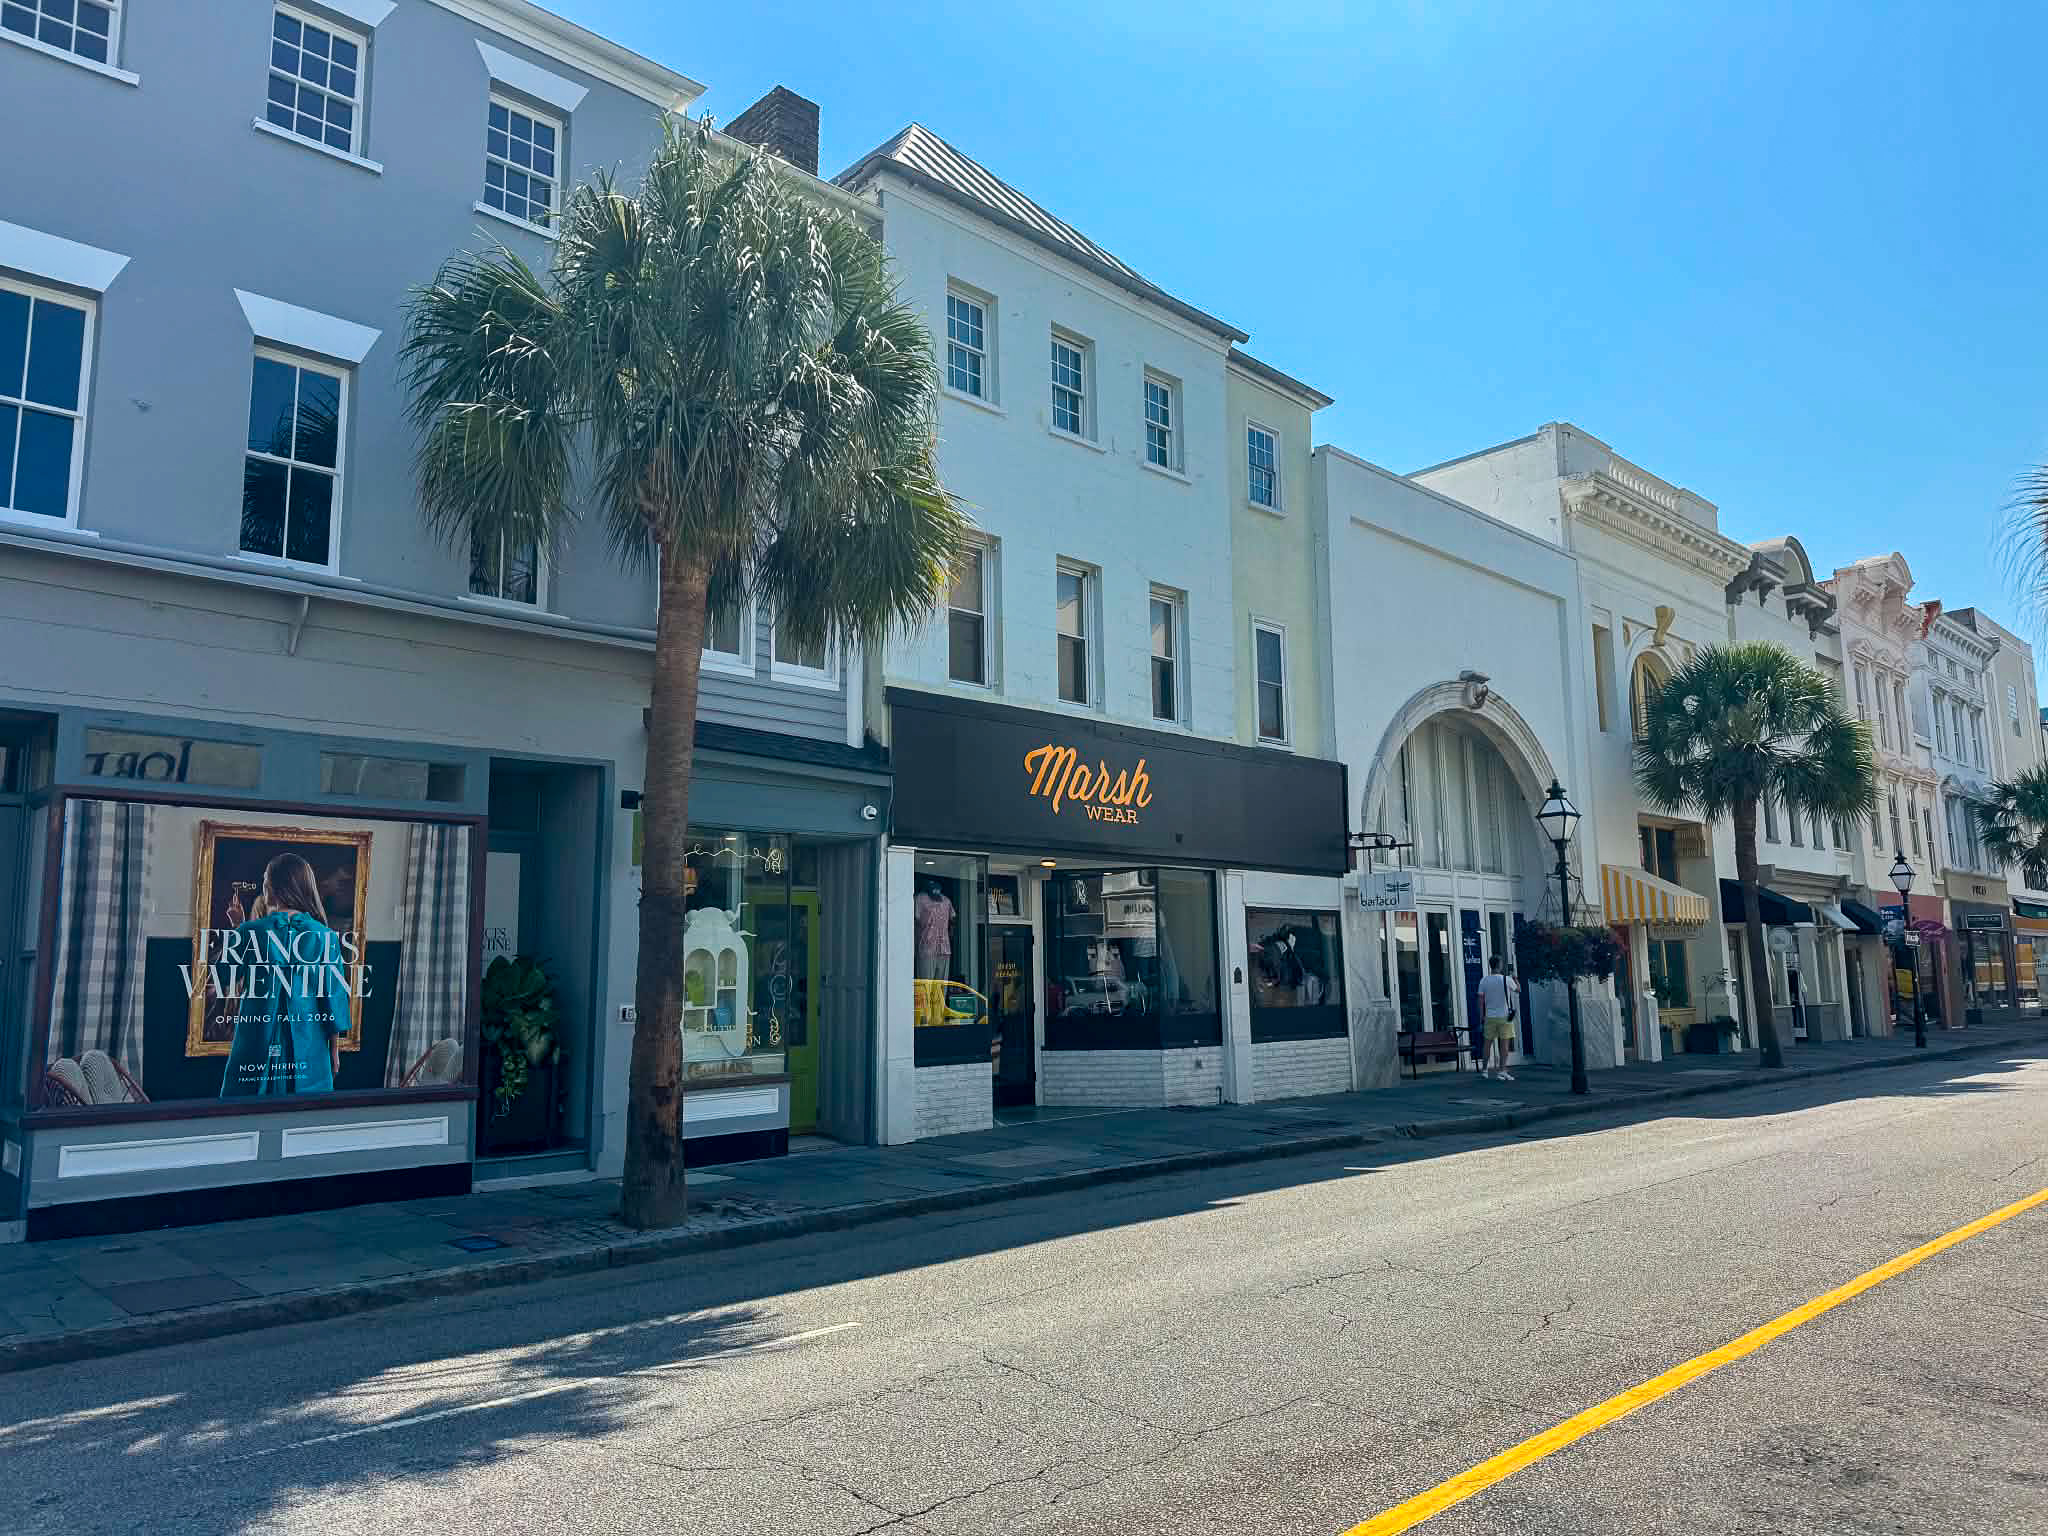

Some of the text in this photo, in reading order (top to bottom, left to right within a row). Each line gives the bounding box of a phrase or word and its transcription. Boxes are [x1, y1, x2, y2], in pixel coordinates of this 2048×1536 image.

[1024, 744, 1152, 815] Marsh
[1084, 804, 1138, 824] WEAR
[199, 928, 360, 965] FRANCES
[177, 964, 373, 999] VALENTINE
[215, 1012, 335, 1024] OPENING FALL 2026
[239, 1062, 307, 1072] NOW HIRING
